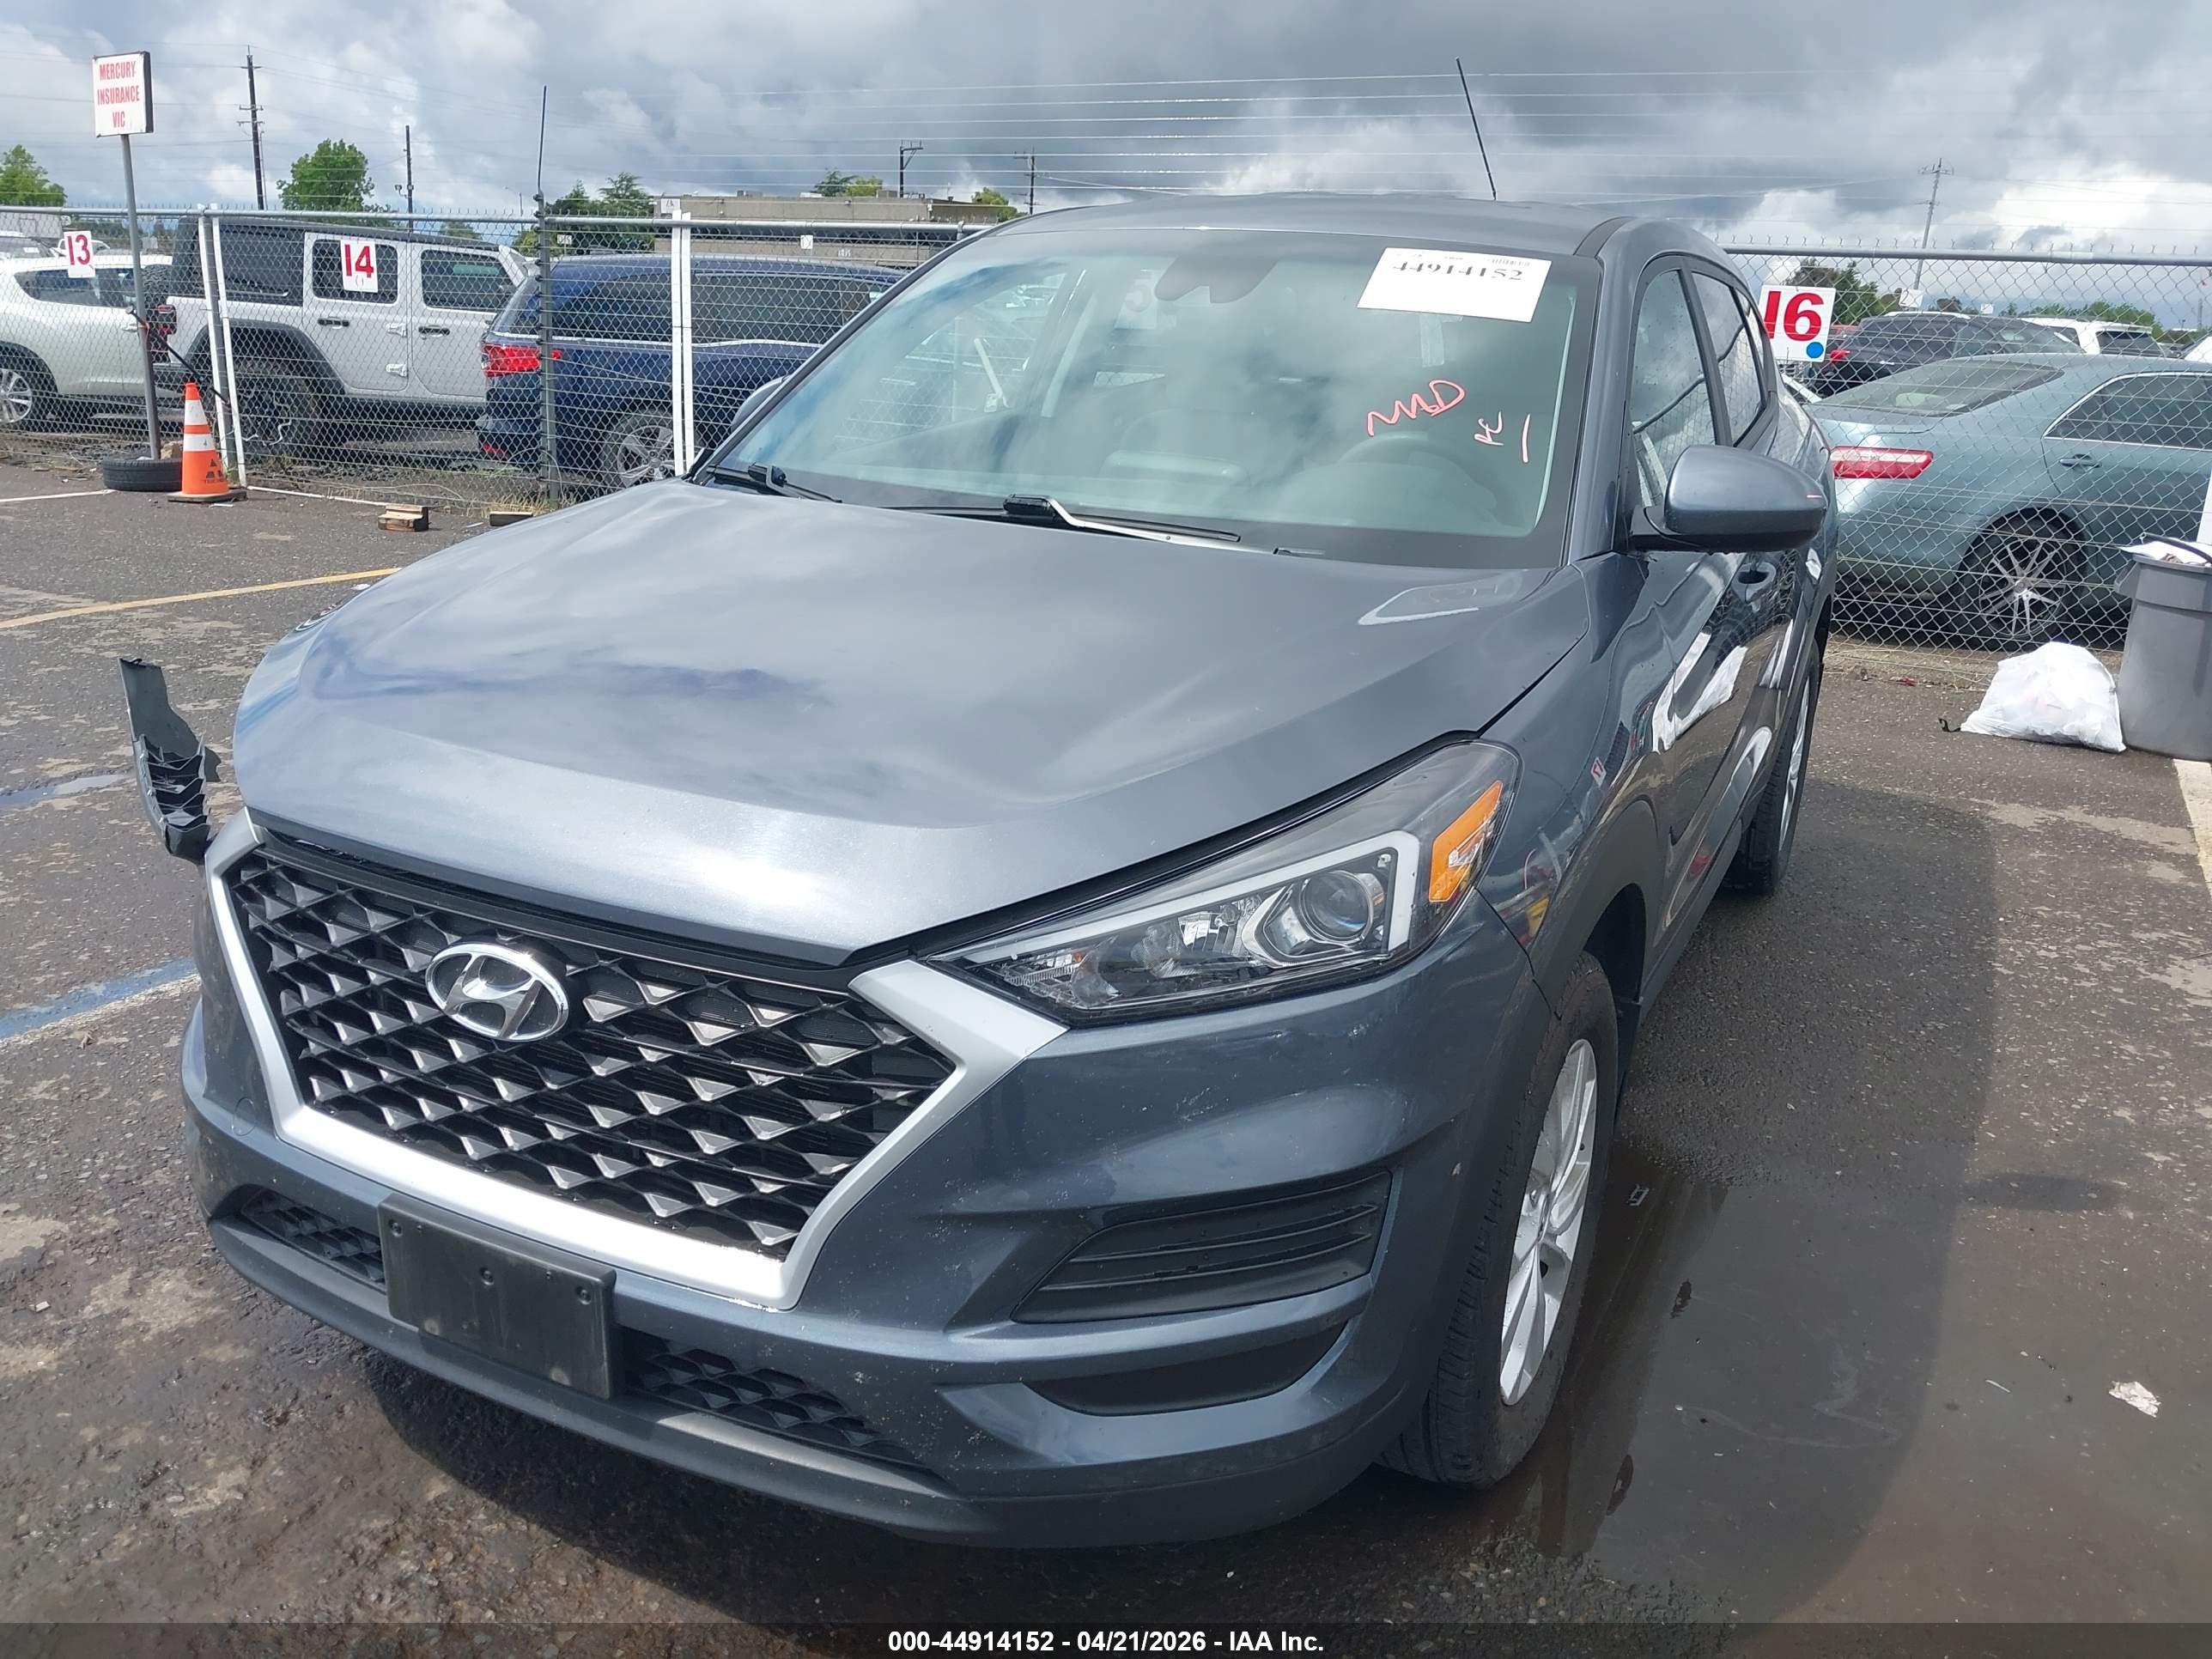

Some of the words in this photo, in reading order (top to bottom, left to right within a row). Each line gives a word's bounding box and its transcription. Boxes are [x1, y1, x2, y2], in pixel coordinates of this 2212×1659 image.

[99, 61, 136, 81] MERCURY
[97, 85, 140, 105] INSURANCE
[112, 111, 125, 128] VIC
[67, 234, 91, 265] 13
[344, 244, 374, 278] 14
[1392, 261, 1523, 281] 44914152
[1763, 290, 1825, 342] 16
